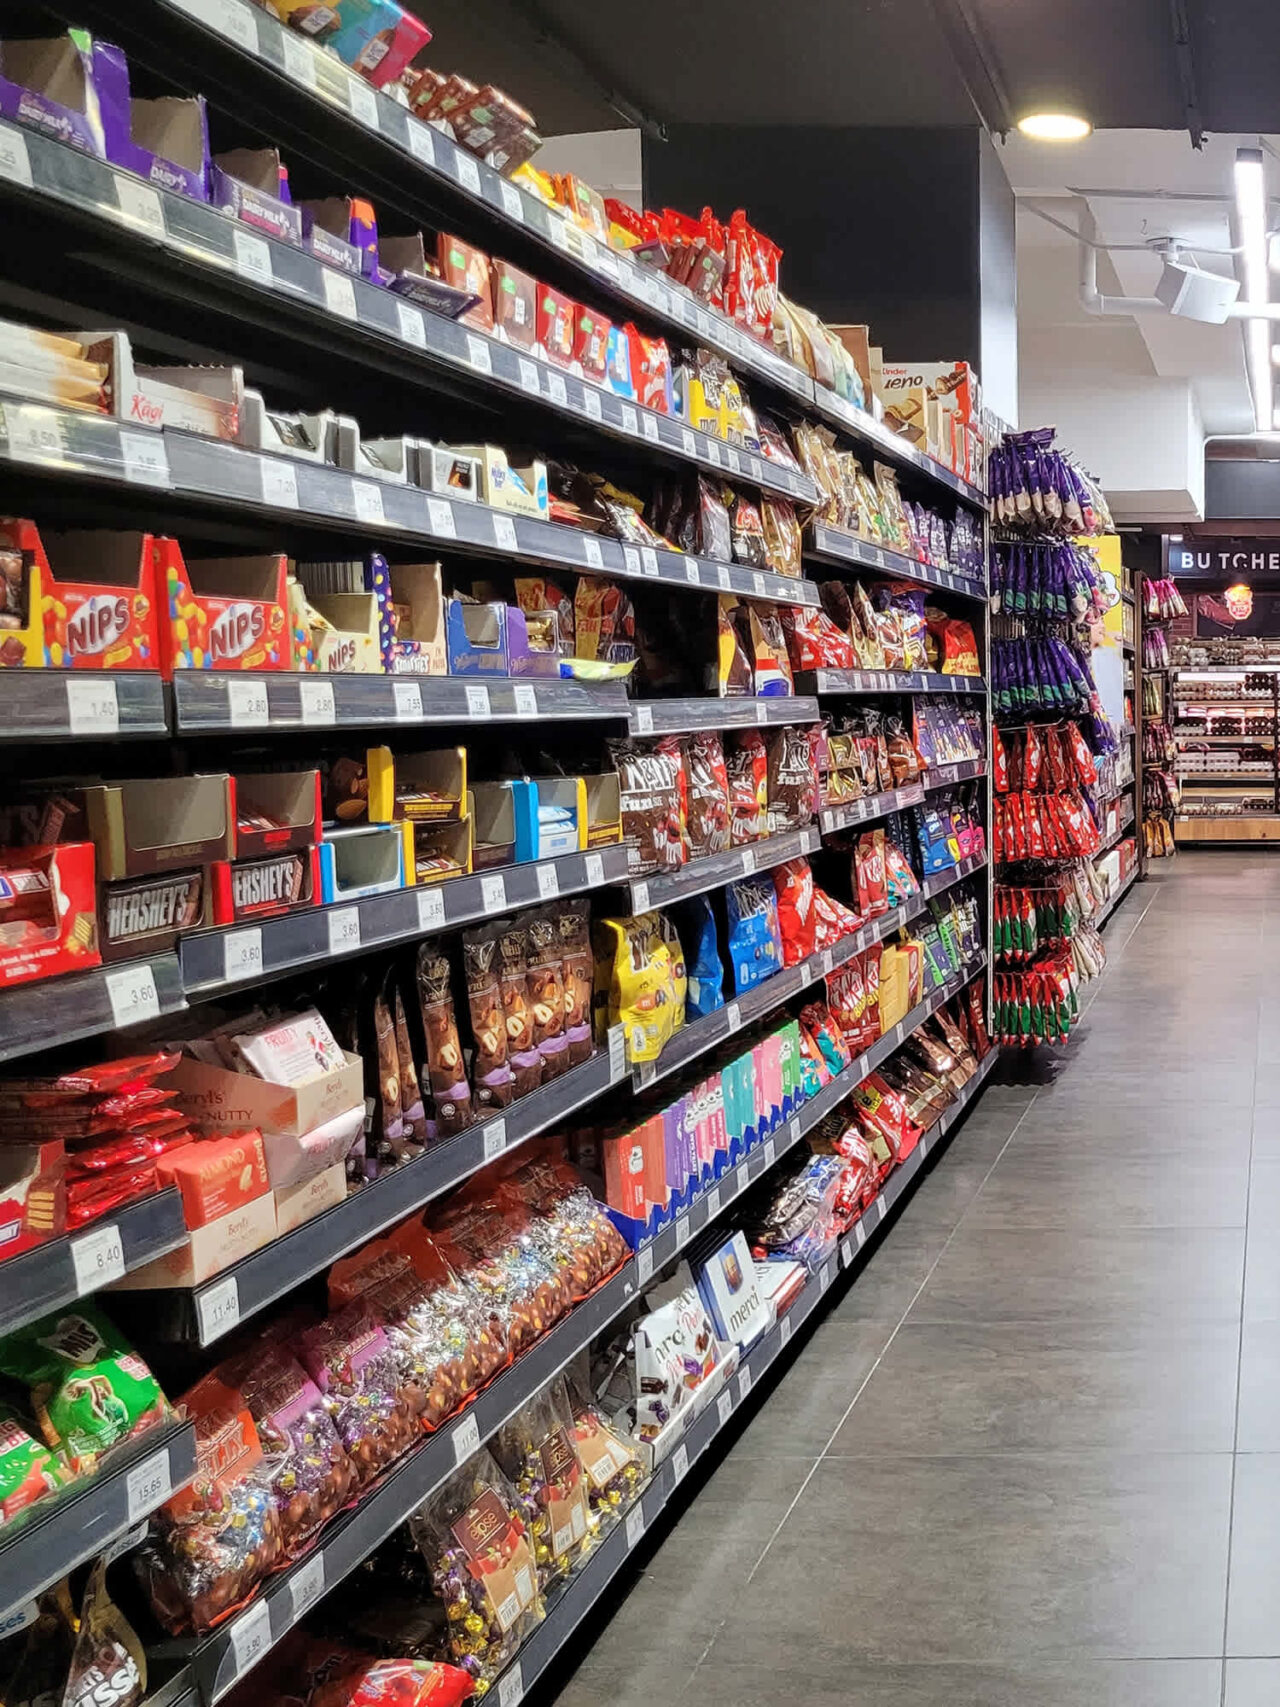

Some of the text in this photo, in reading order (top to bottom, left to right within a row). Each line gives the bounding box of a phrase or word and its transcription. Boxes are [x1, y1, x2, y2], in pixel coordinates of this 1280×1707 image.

[248, 699, 266, 714] 2.80
[232, 861, 294, 908] ERSHEY'S
[108, 883, 190, 939] HERSHEY'S
[342, 923, 358, 938] 3.60
[241, 946, 260, 962] 3.60
[131, 985, 154, 1004] 3.60
[206, 1109, 254, 1122] NUTTY
[729, 1285, 760, 1333] merci
[138, 1477, 162, 1500] 15.65
